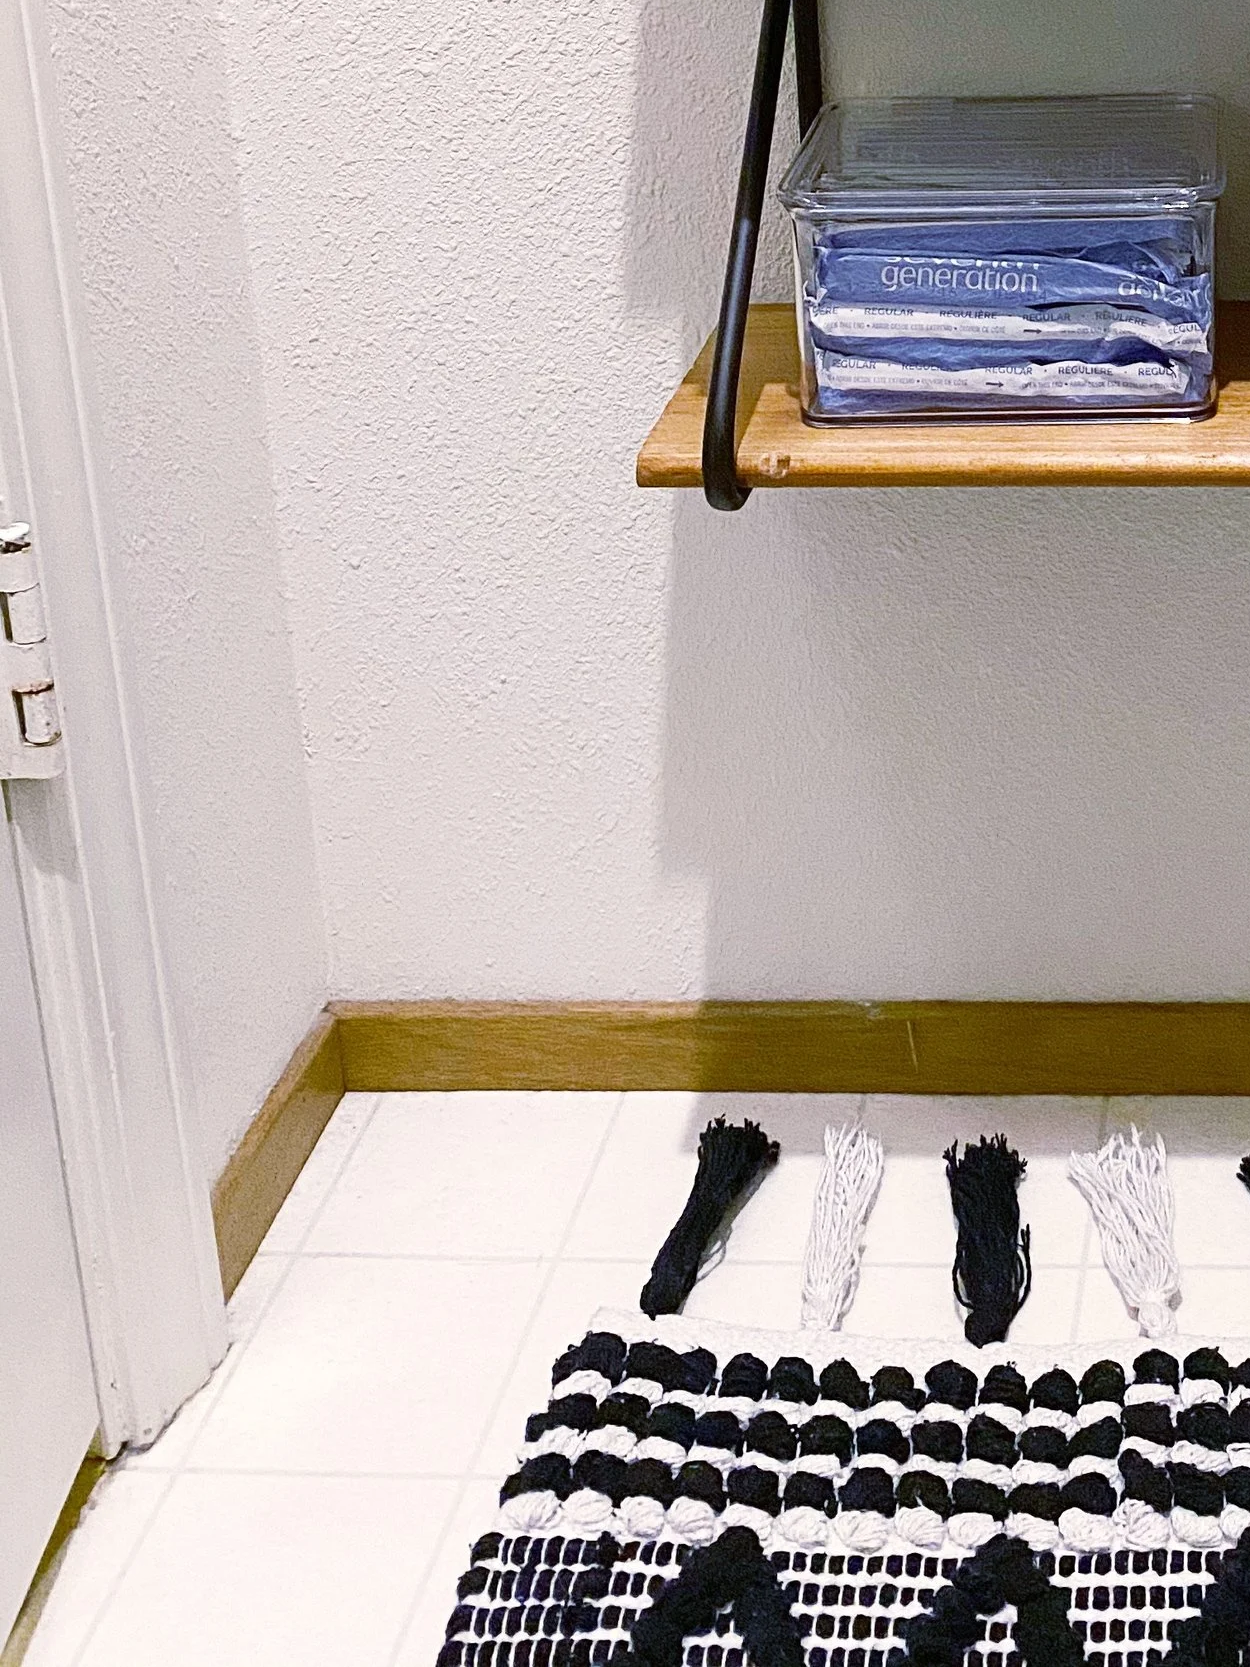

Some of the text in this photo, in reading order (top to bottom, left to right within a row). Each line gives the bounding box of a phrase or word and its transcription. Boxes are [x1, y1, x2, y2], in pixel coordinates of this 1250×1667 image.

[881, 264, 1038, 293] generation
[864, 307, 914, 316] REGULAR
[985, 365, 1033, 376] REGULAR
